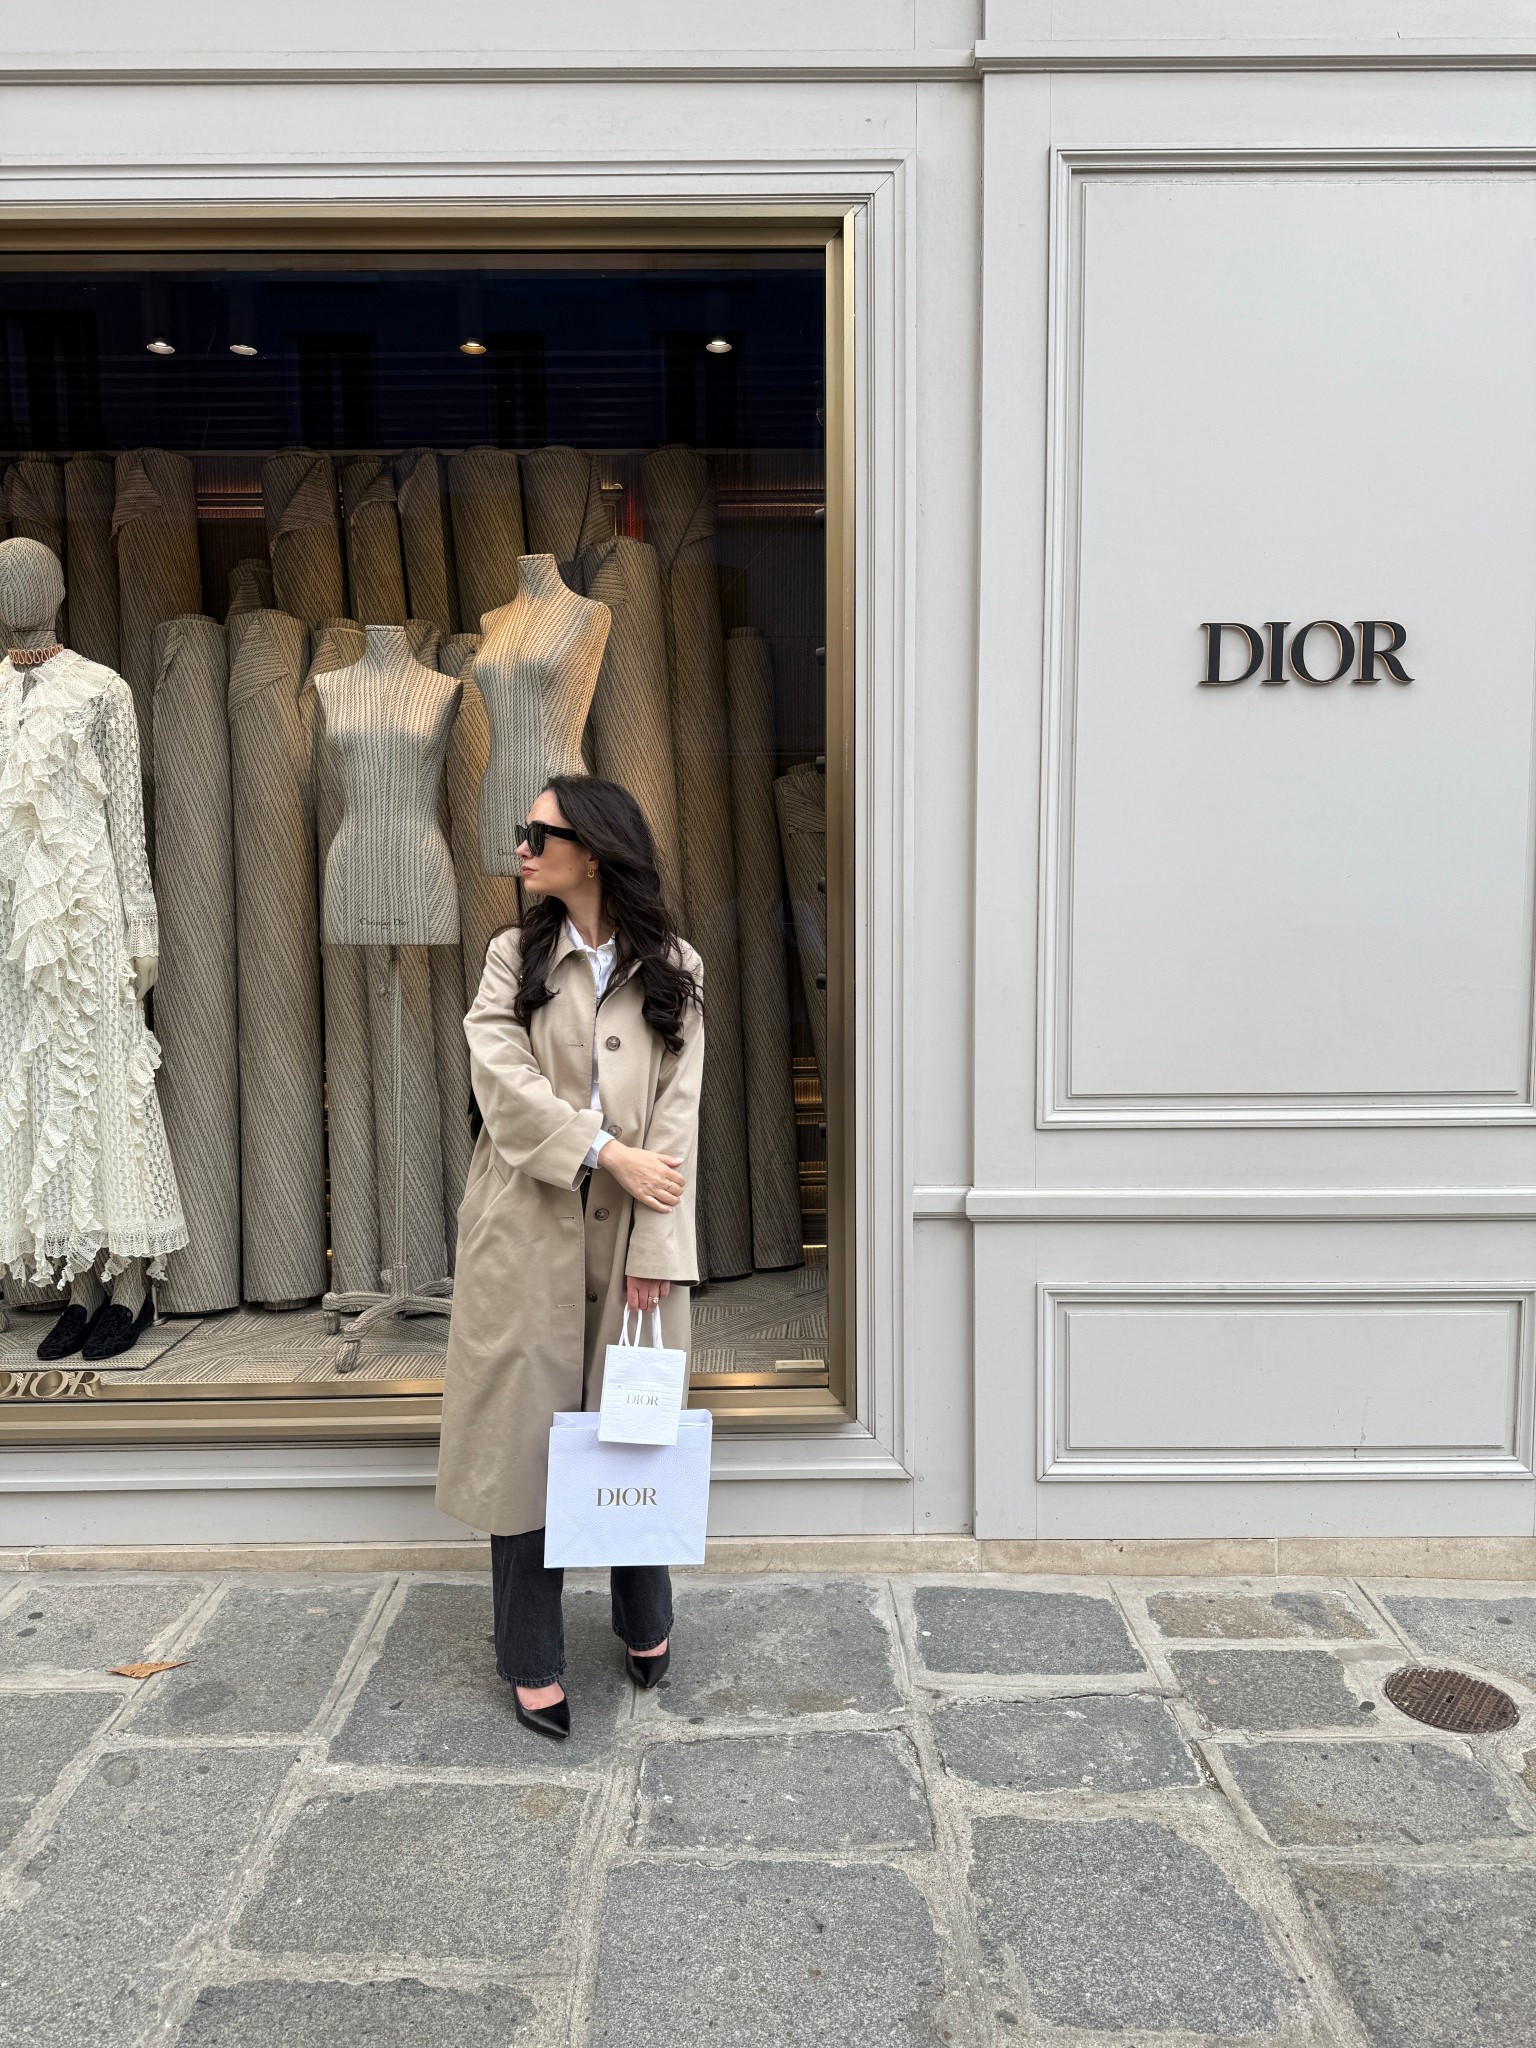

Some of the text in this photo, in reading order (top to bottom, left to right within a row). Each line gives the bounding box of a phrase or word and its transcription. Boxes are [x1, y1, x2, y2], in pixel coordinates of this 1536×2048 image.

[1199, 620, 1415, 684] DIOR
[626, 1393, 659, 1406] DIOR
[596, 1487, 658, 1506] DIOR
